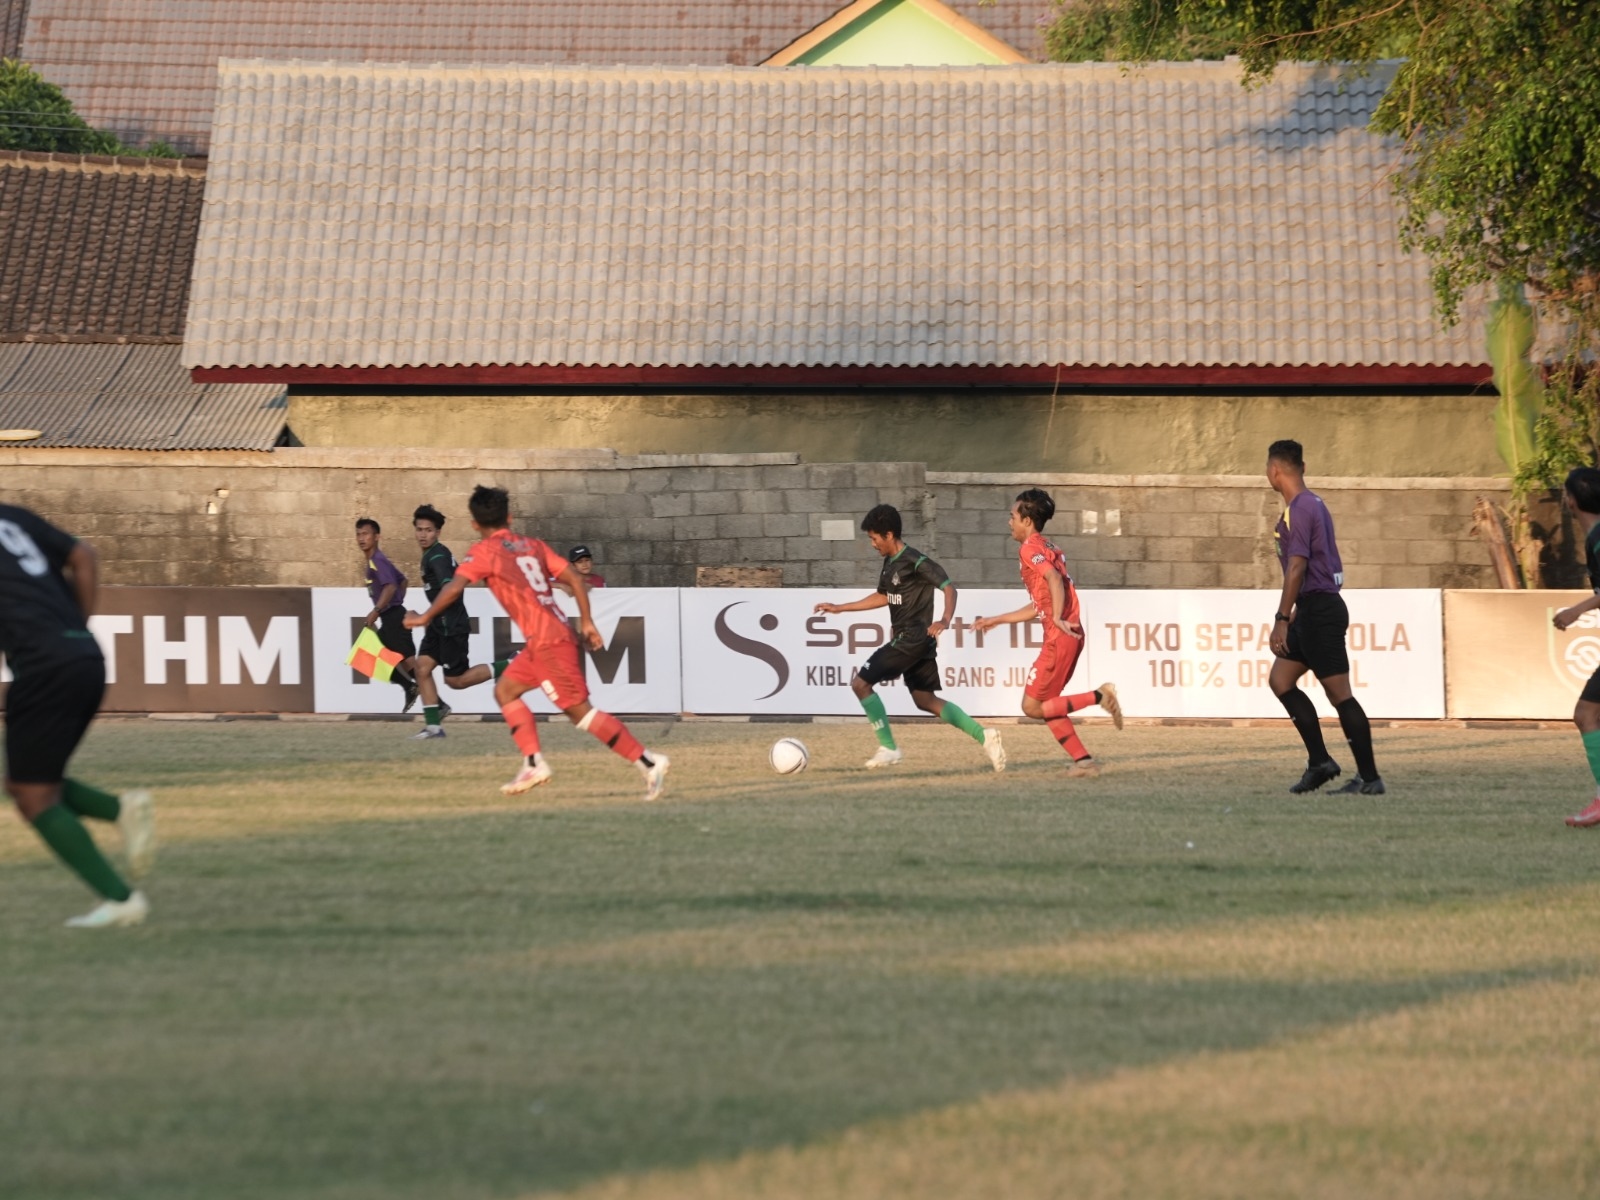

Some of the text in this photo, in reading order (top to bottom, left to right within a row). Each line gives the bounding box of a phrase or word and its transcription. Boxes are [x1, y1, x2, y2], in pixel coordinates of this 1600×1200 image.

[0, 518, 48, 577] 9
[516, 555, 549, 593] 8
[0, 615, 301, 684] THM
[1105, 623, 1411, 651] TOKO SEPA OLA
[945, 667, 995, 688] SANG
[1149, 659, 1225, 688] 100%
